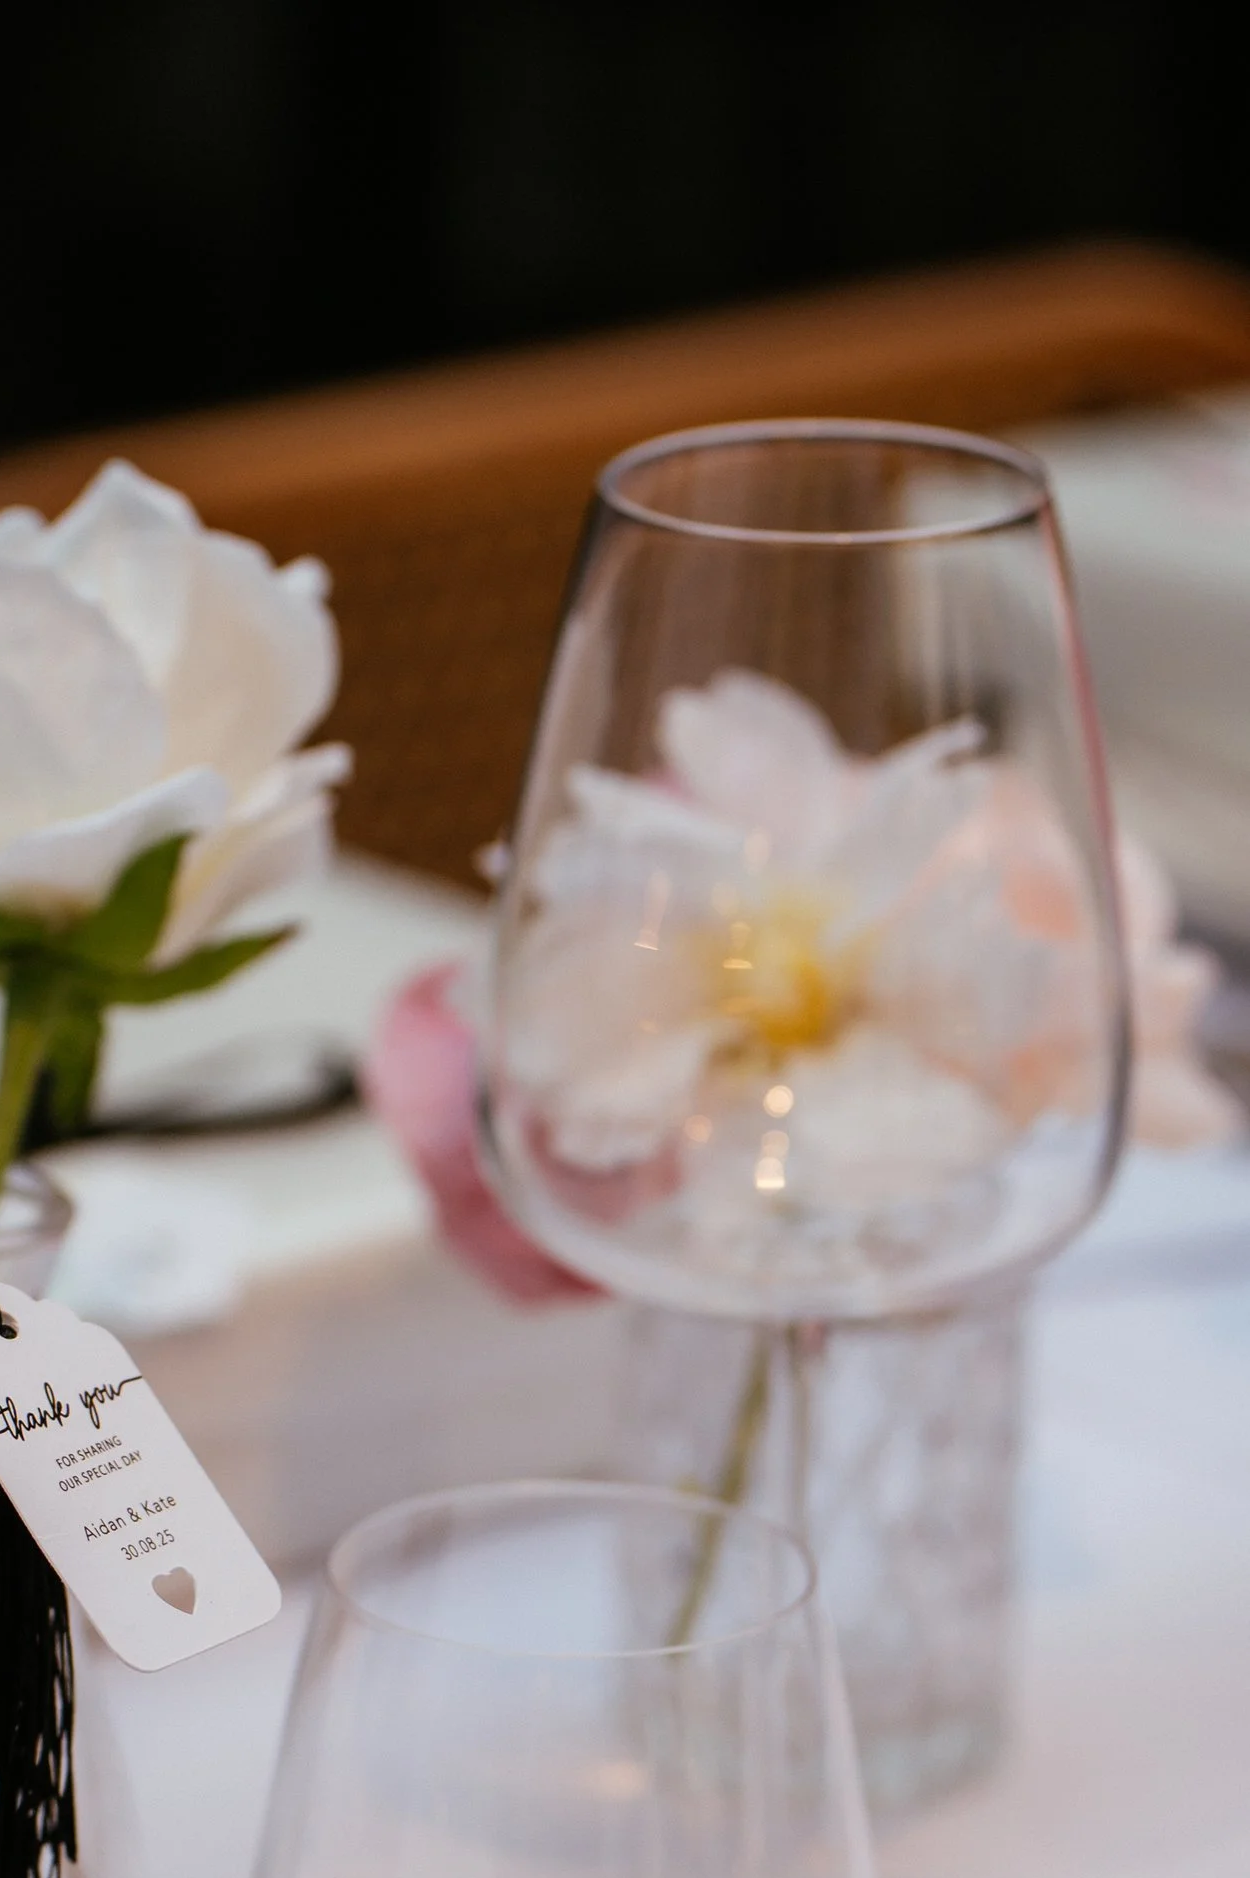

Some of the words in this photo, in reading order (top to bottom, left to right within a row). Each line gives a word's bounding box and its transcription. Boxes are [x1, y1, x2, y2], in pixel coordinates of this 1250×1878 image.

[78, 1374, 143, 1429] you
[55, 1449, 78, 1470] FOR
[77, 1434, 123, 1463] SHARING
[58, 1471, 83, 1493] OUR
[81, 1459, 123, 1485] SPECIAL
[121, 1449, 143, 1470] DAY
[83, 1511, 128, 1542] Aidan
[126, 1505, 142, 1524] &
[141, 1492, 178, 1517] Kate
[120, 1528, 176, 1562] 30.08.25
